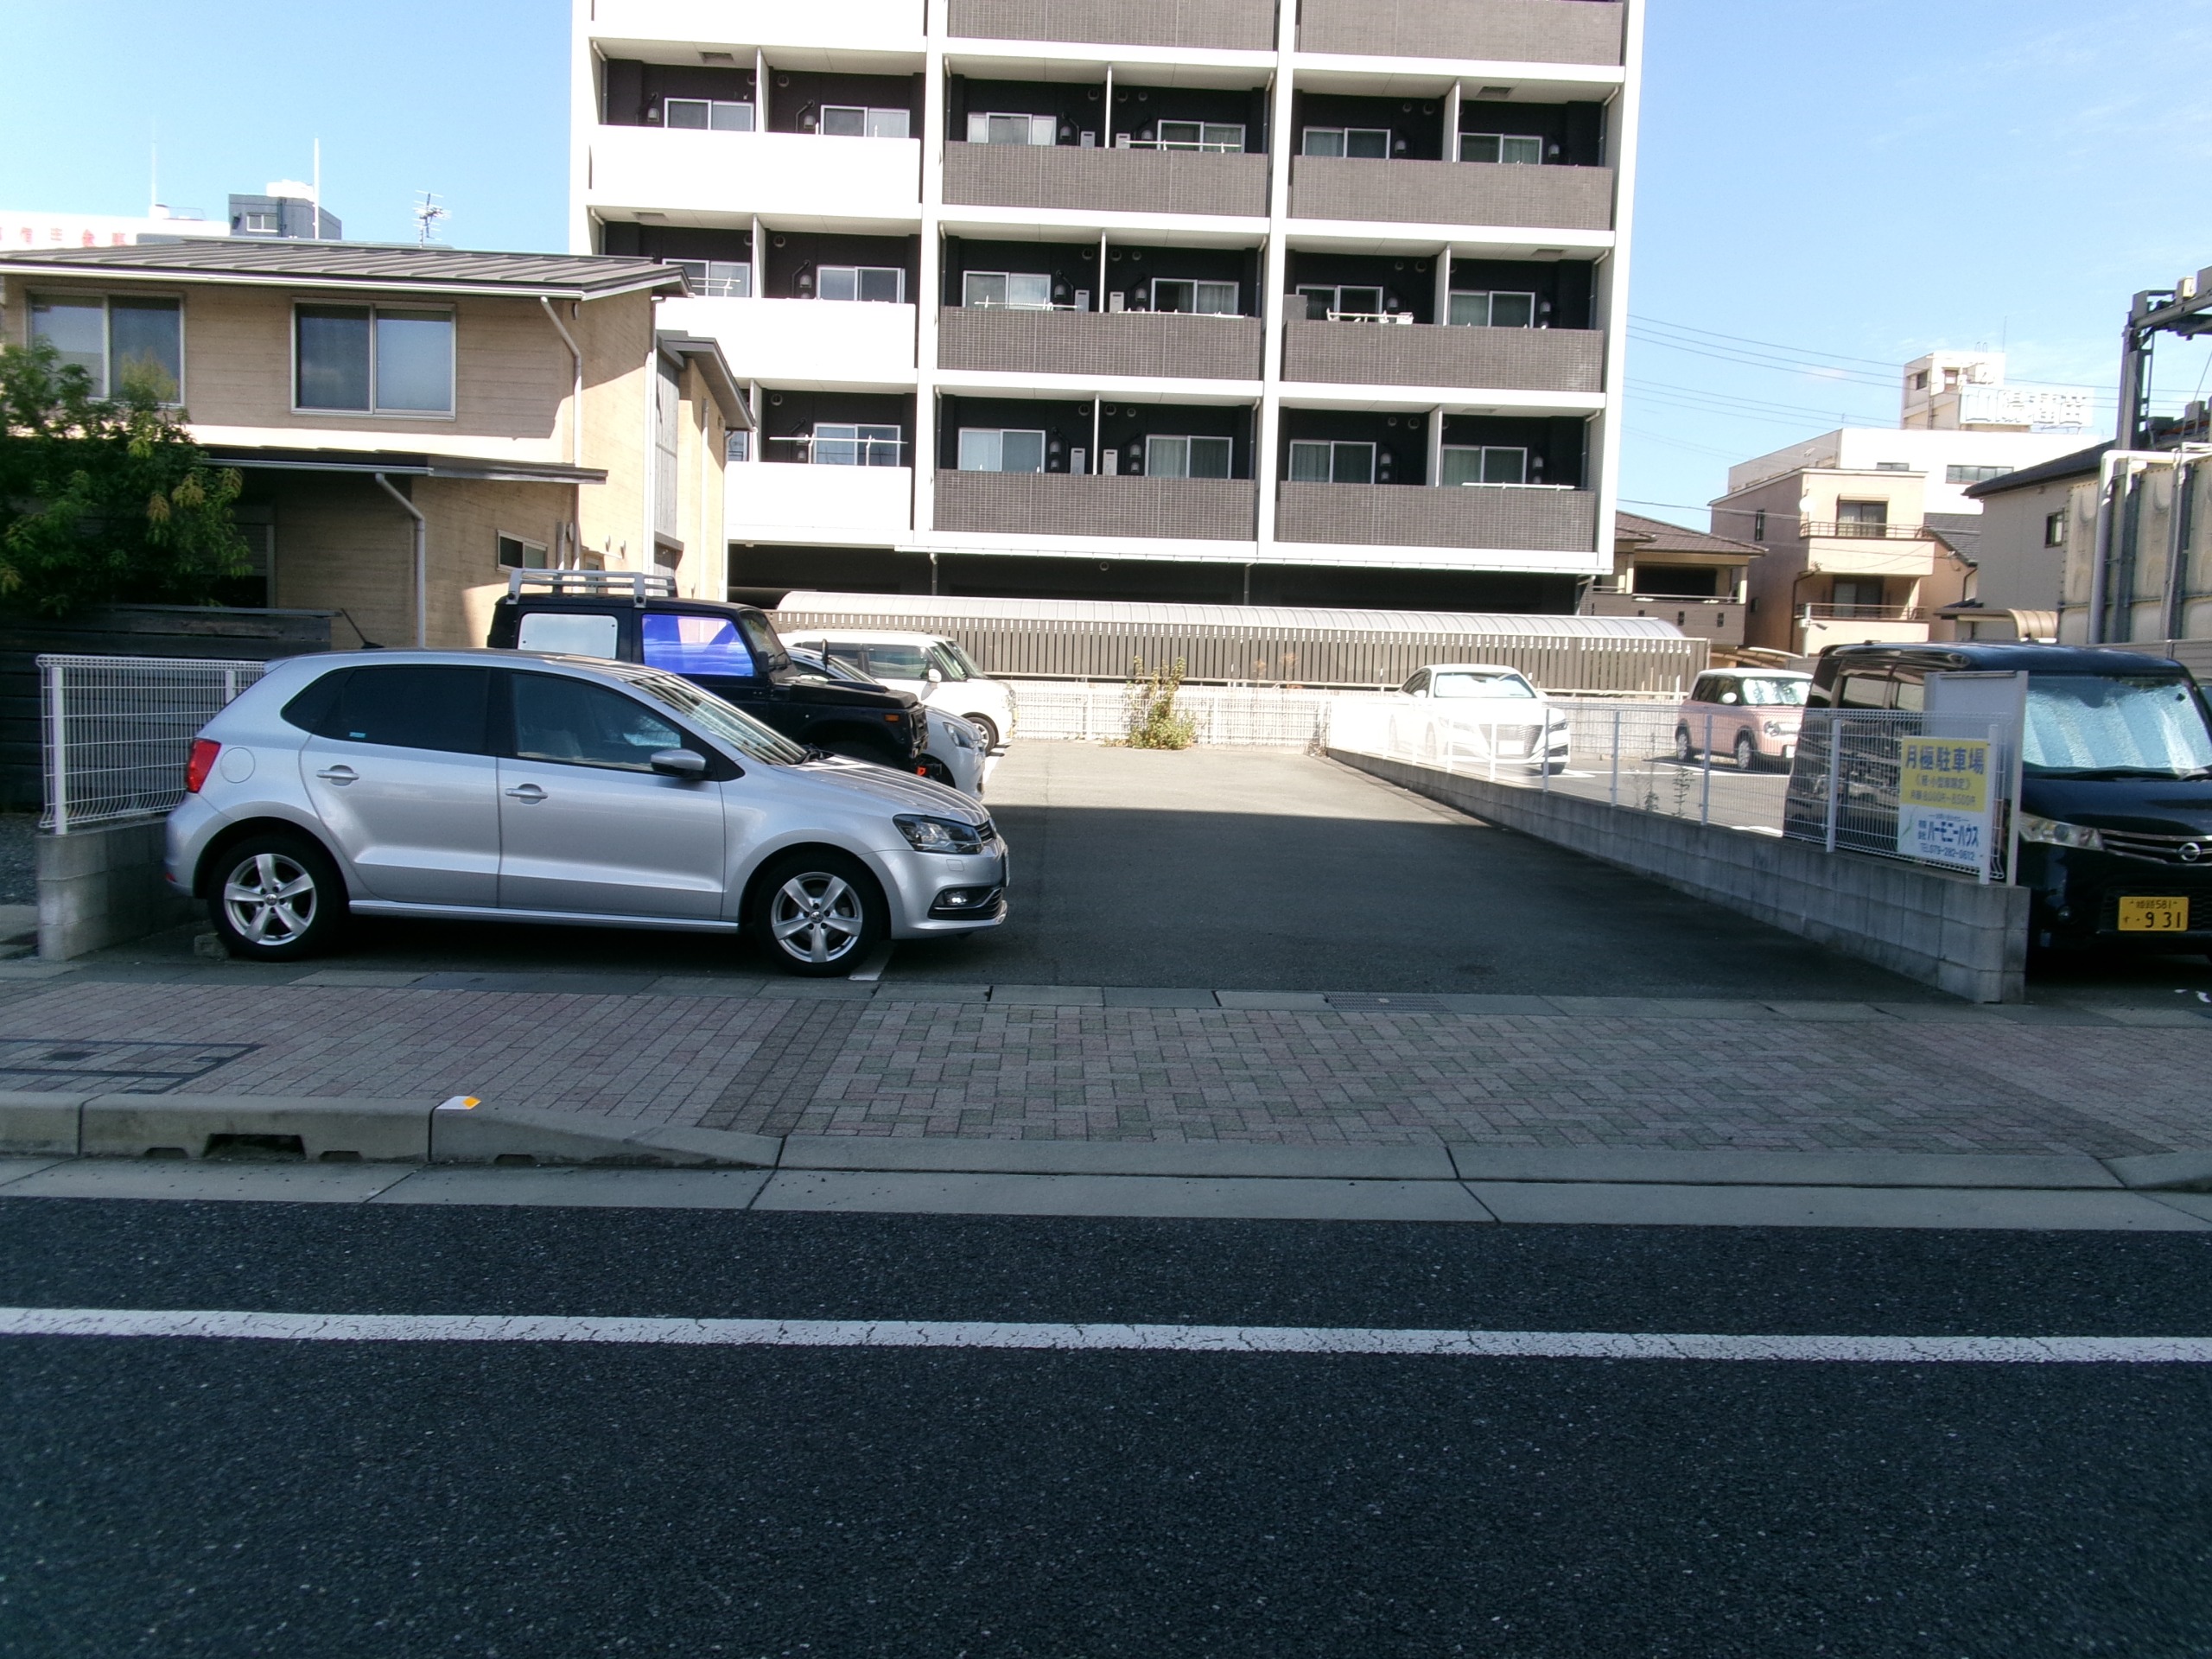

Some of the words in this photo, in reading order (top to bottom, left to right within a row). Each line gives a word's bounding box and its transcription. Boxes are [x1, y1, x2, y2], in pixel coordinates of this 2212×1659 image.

[1906, 745, 1985, 774] 月極駐車場
